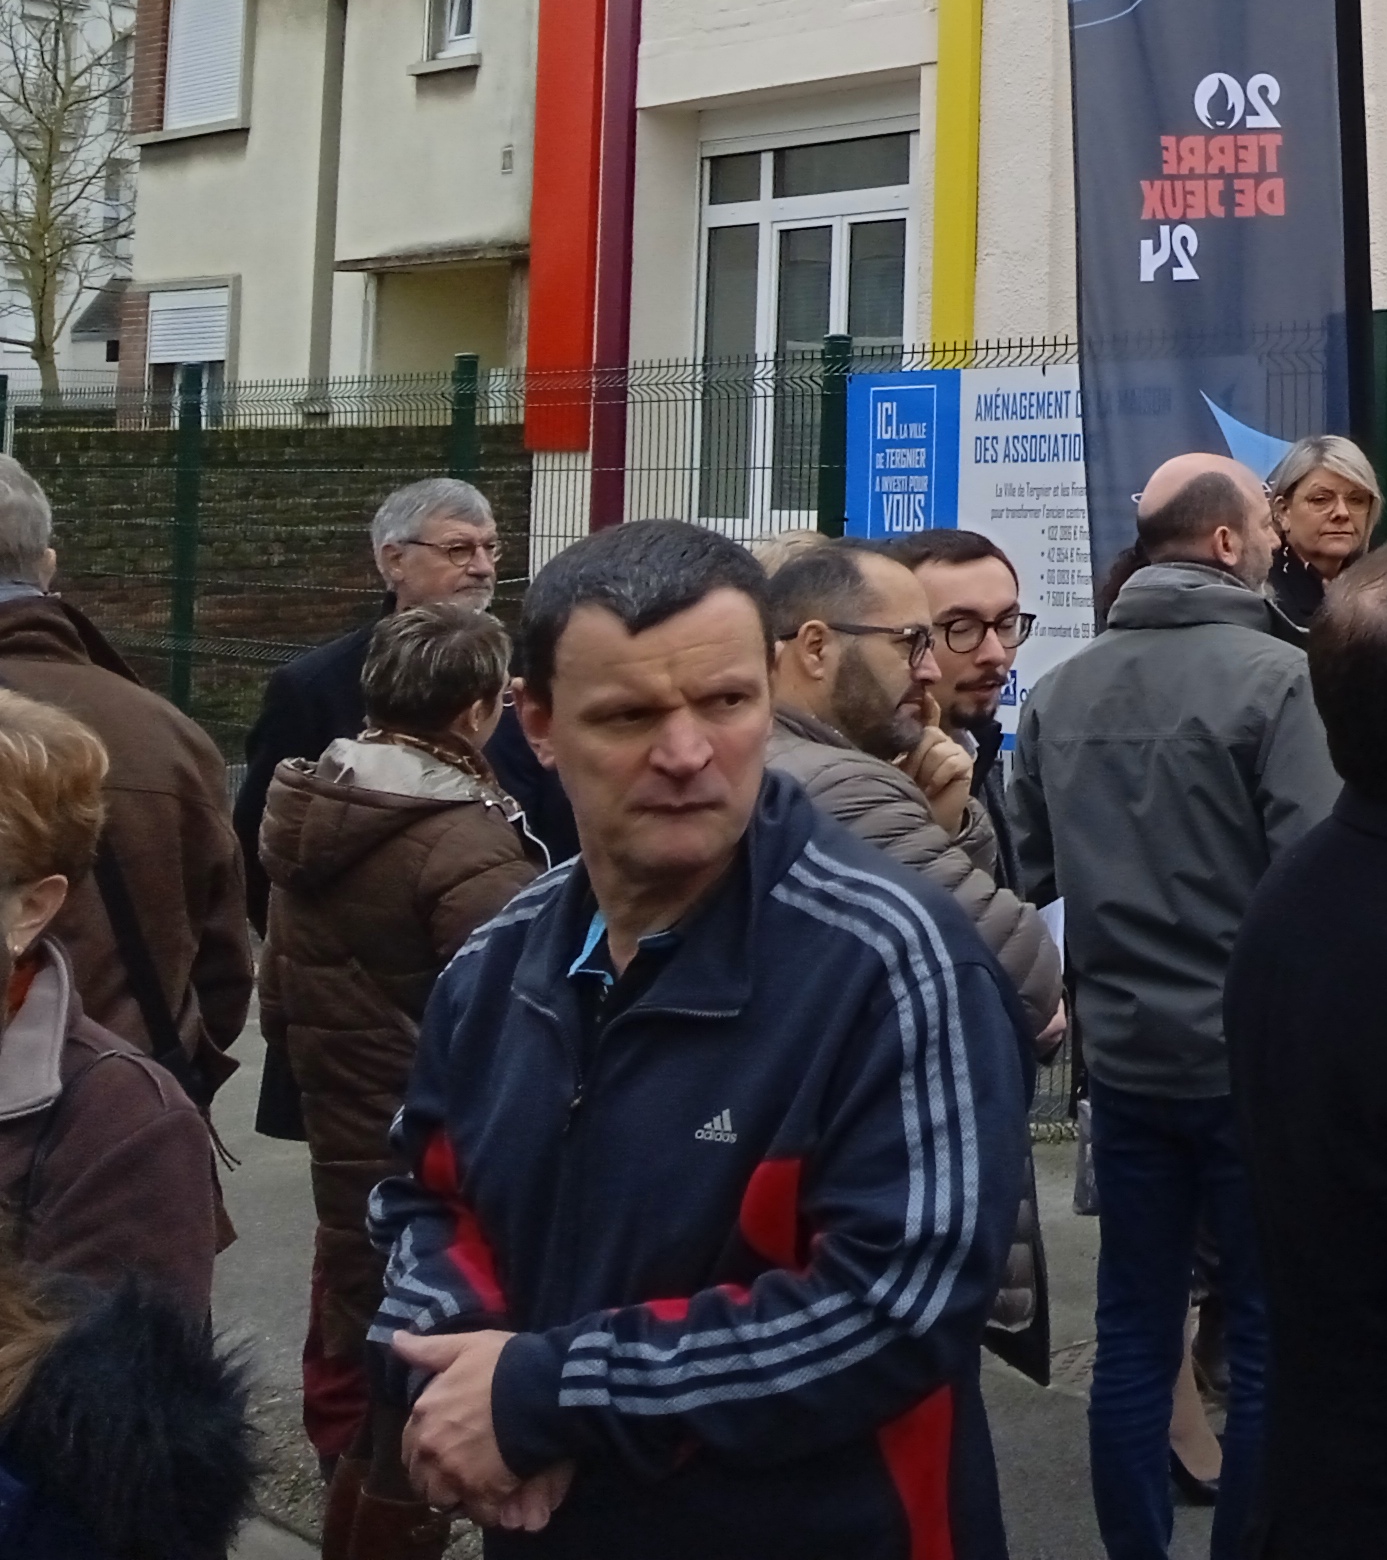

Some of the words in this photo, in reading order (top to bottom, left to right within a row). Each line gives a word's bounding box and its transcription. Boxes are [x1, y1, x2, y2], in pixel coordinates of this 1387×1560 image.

[974, 386, 1072, 421] AMÉNAGEMENT
[899, 423, 908, 439] LA
[908, 423, 927, 439] VILLE
[875, 452, 885, 469] DE
[885, 447, 927, 469] TERGNIER
[974, 435, 999, 464] DES
[1002, 433, 1084, 464] ASSOCIATIO
[874, 475, 881, 492] A
[881, 475, 908, 493] INVESTI
[908, 475, 929, 493] POUR
[883, 493, 925, 532] VOUS
[694, 1128, 738, 1144] adidas
